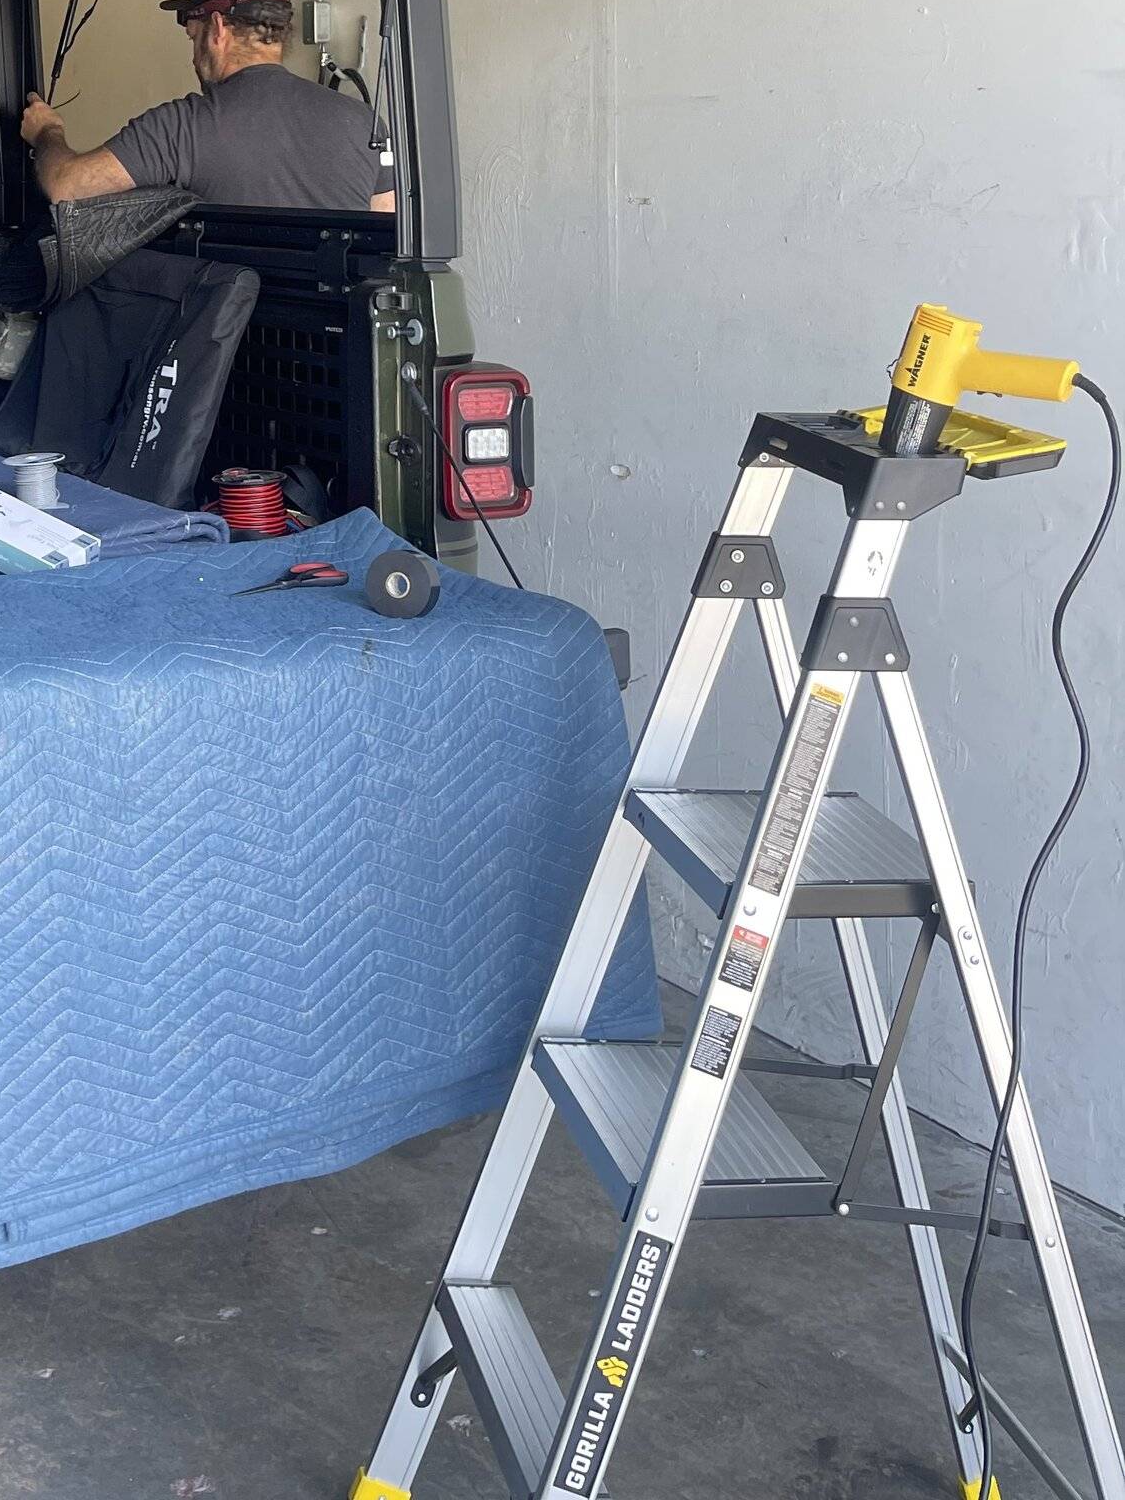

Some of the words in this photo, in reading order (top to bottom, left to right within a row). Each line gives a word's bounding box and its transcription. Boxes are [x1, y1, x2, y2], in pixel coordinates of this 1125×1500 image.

[907, 333, 931, 389] WAGNER
[611, 1243, 662, 1353] LADDERS
[564, 1391, 614, 1491] GORILLA
